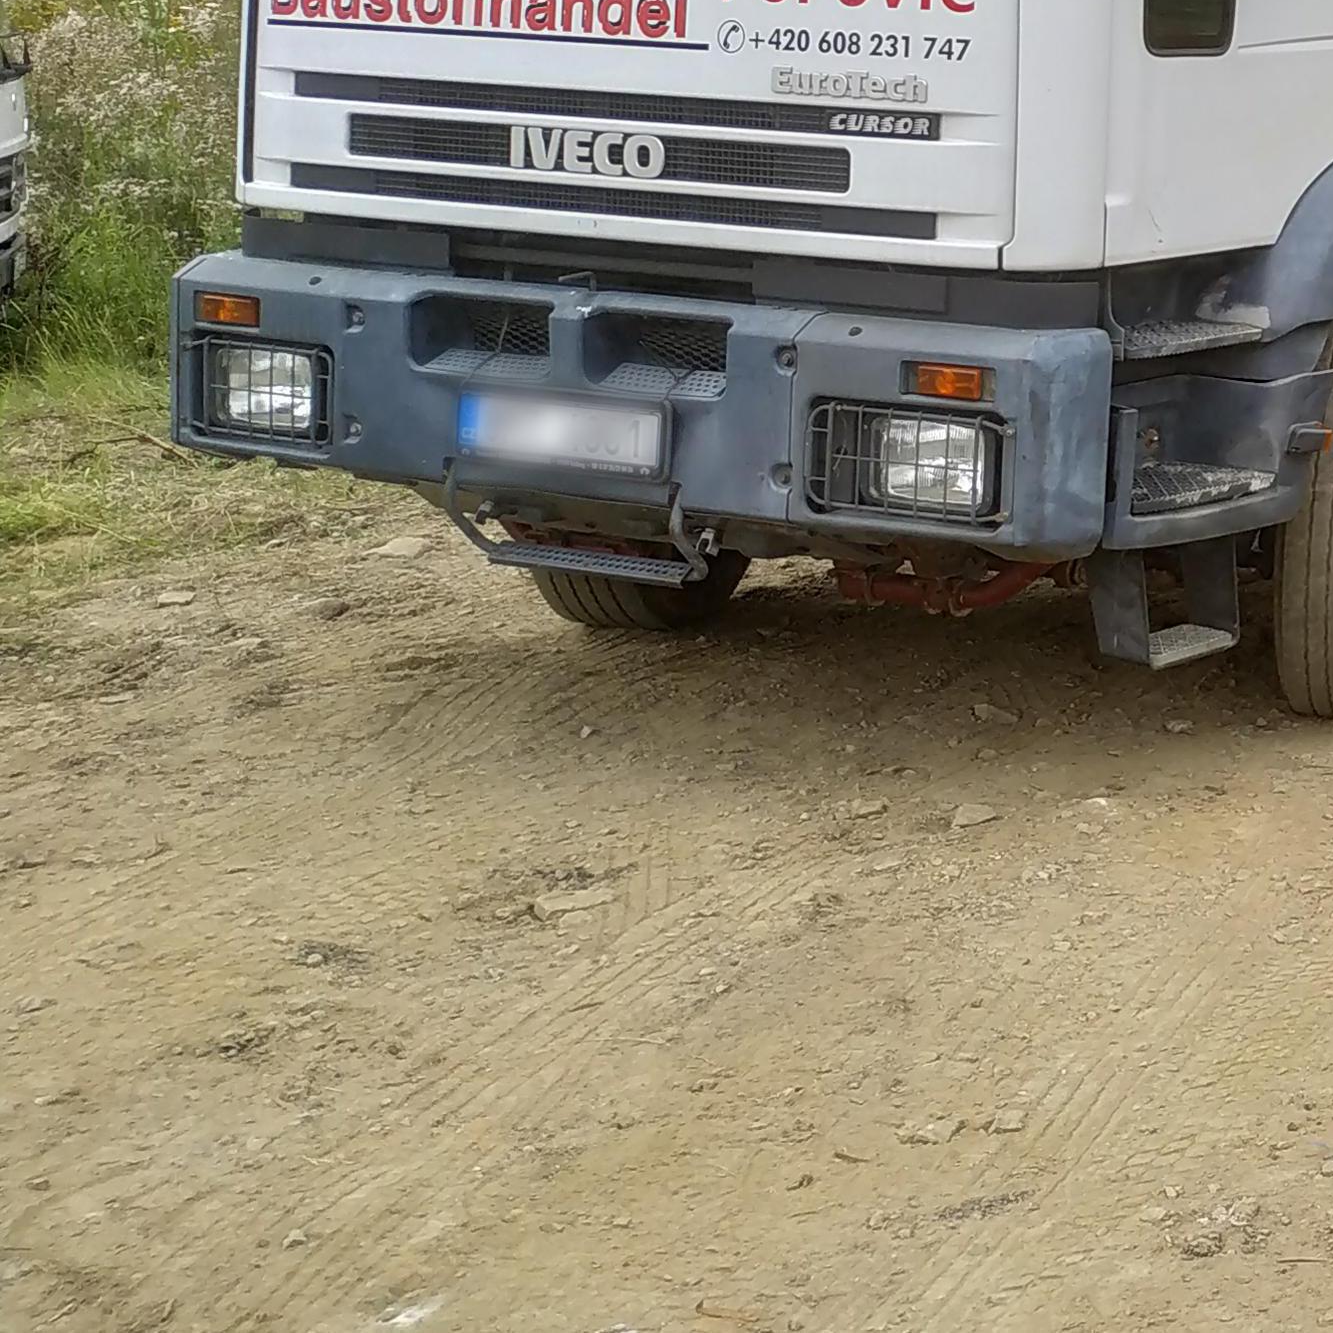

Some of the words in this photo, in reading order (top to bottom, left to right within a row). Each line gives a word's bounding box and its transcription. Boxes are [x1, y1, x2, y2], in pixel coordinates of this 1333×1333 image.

[748, 28, 810, 52] +420
[818, 31, 861, 55] 608
[869, 34, 910, 58] 231
[922, 37, 972, 61] 747
[771, 66, 929, 103] EuroTech
[829, 113, 931, 136] CURSOR
[510, 125, 665, 179] IVECO
